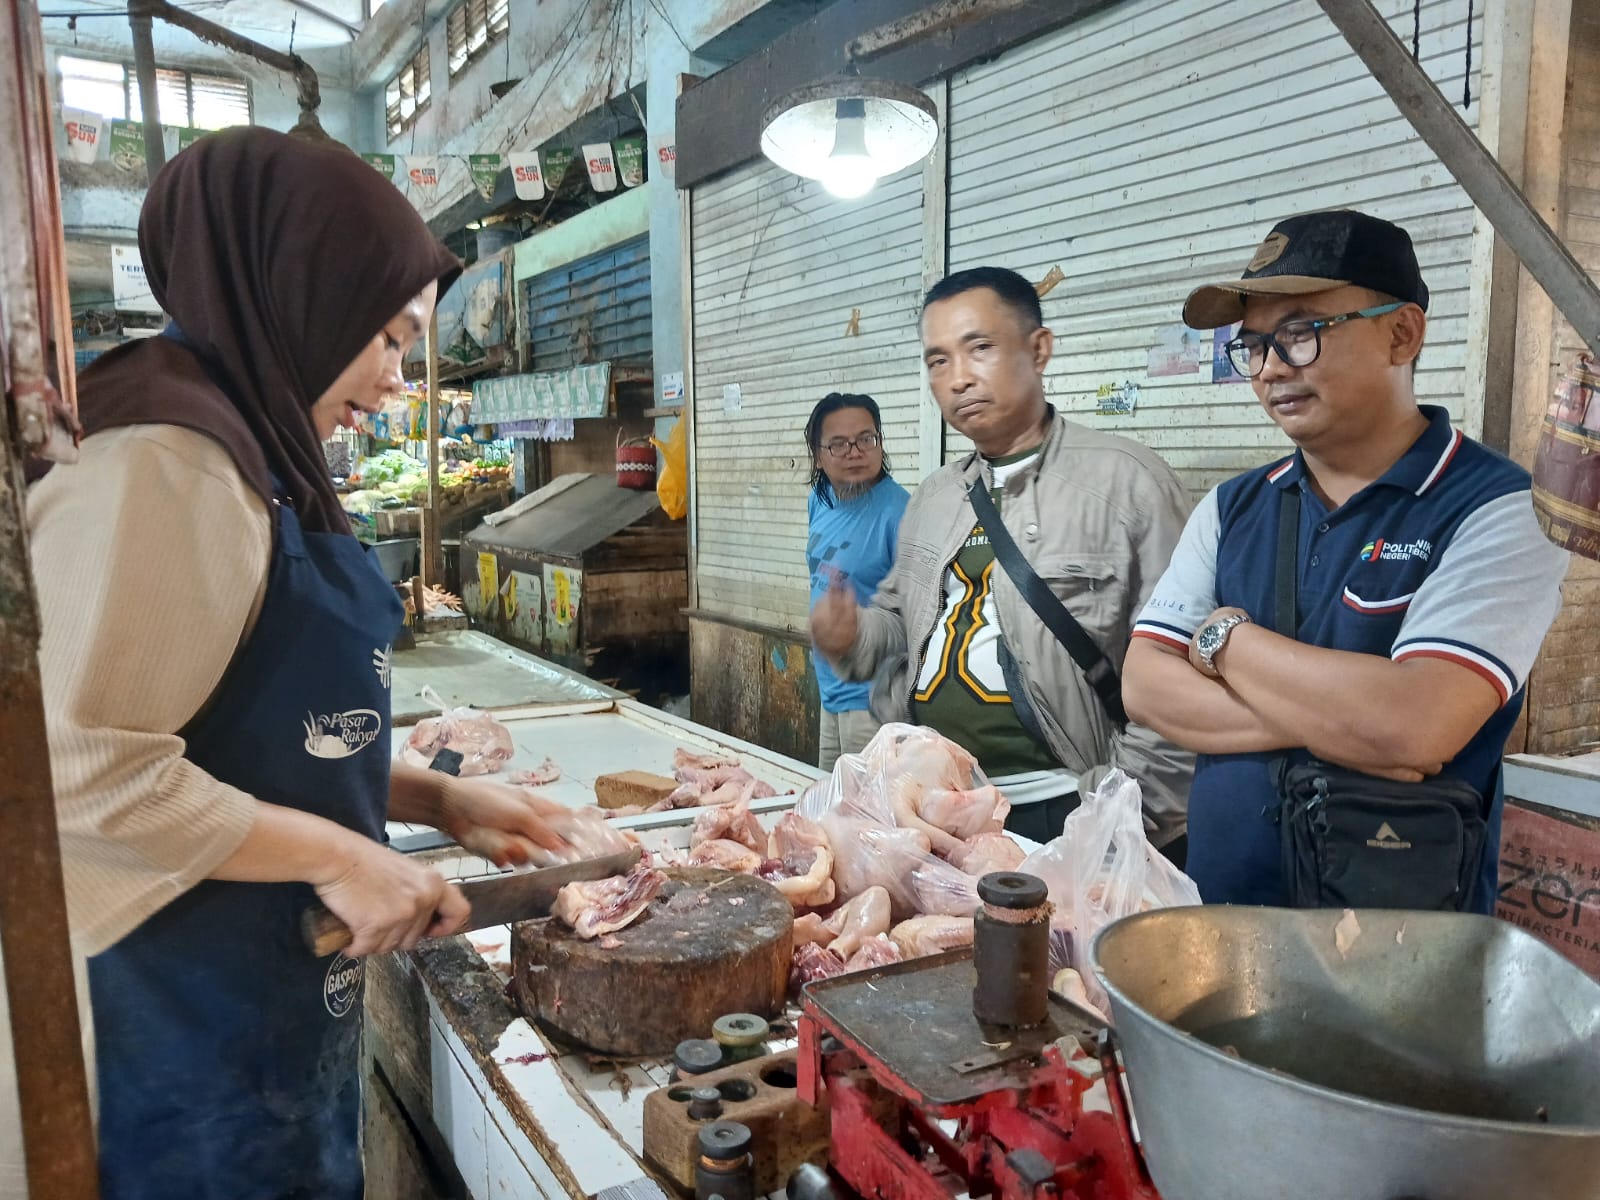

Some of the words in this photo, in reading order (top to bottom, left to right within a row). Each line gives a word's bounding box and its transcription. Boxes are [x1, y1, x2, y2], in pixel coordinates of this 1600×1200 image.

[514, 165, 539, 183] SUN
[589, 158, 612, 175] SUN
[409, 167, 437, 187] SUN
[330, 712, 368, 729] Pasar
[341, 726, 377, 747] Rakyat
